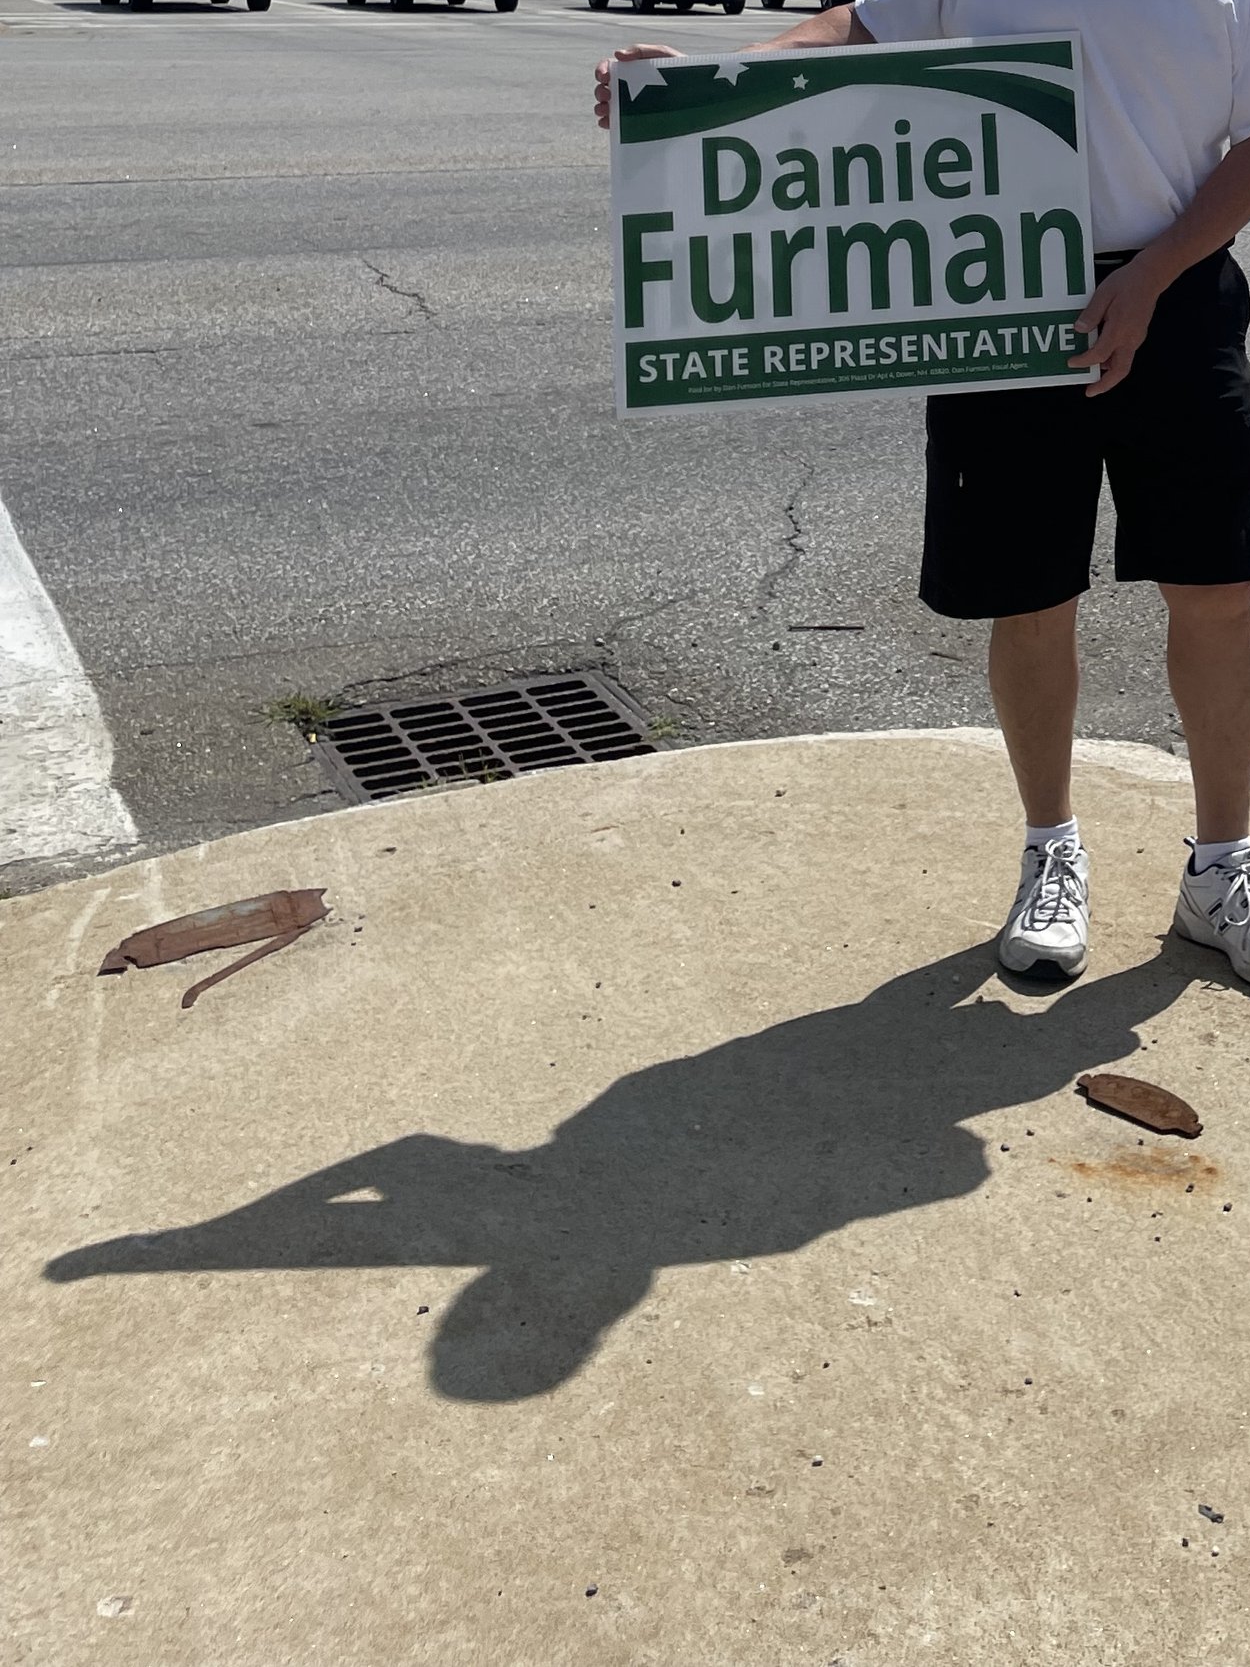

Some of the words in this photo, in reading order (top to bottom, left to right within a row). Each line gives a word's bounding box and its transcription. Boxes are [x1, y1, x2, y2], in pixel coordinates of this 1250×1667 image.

[702, 113, 1001, 216] Daniel
[621, 208, 1086, 329] Furman
[639, 347, 749, 383] STATE
[764, 323, 1076, 374] REPRESENTATIVE
